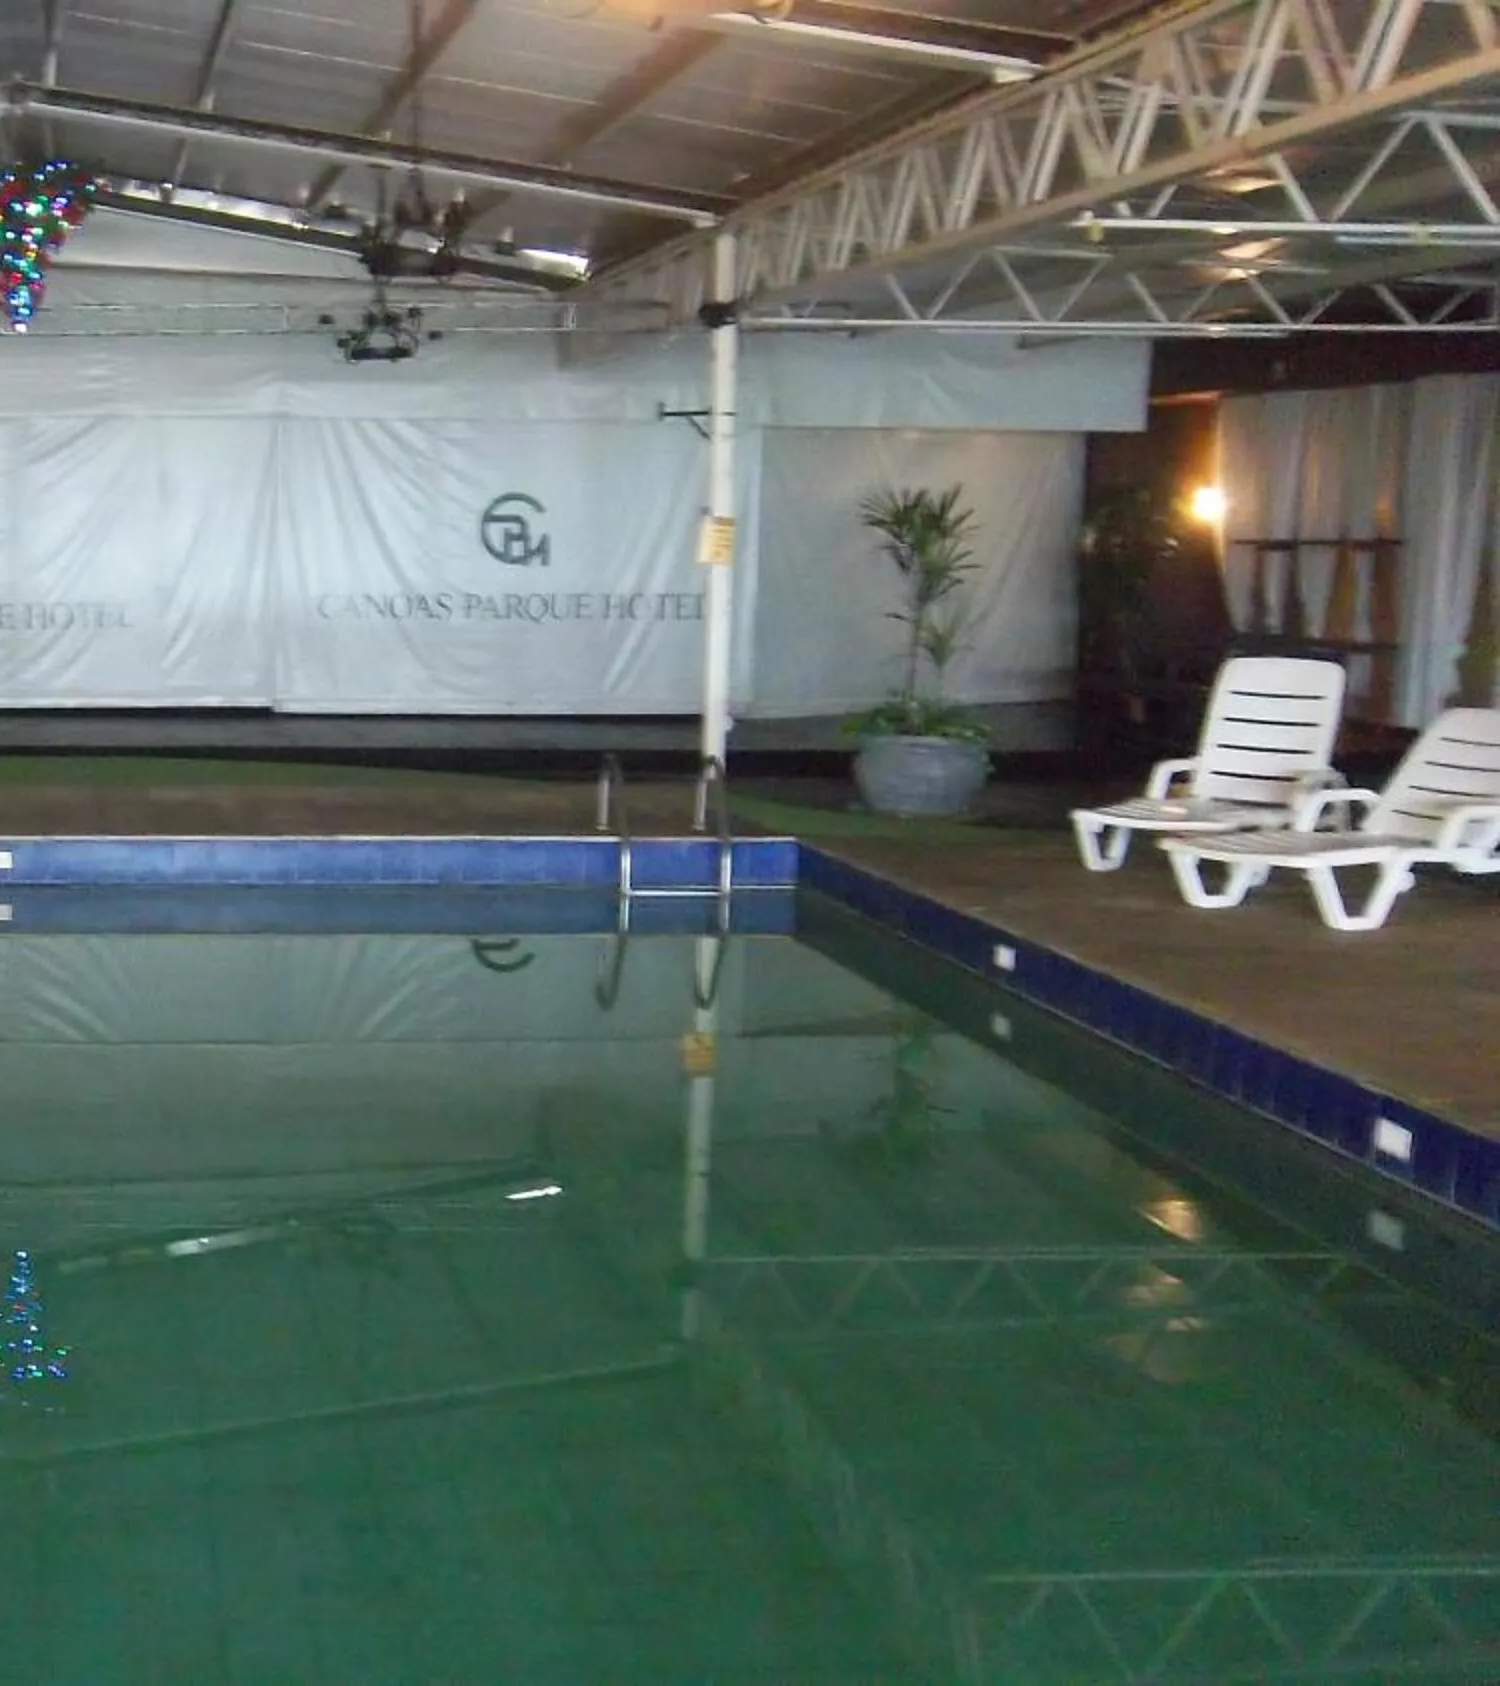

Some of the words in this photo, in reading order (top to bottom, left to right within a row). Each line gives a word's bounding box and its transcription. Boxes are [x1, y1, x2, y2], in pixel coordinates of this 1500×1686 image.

[26, 602, 133, 629] HOTEL
[317, 592, 453, 621] CANOAS
[465, 592, 596, 623] PARQUE
